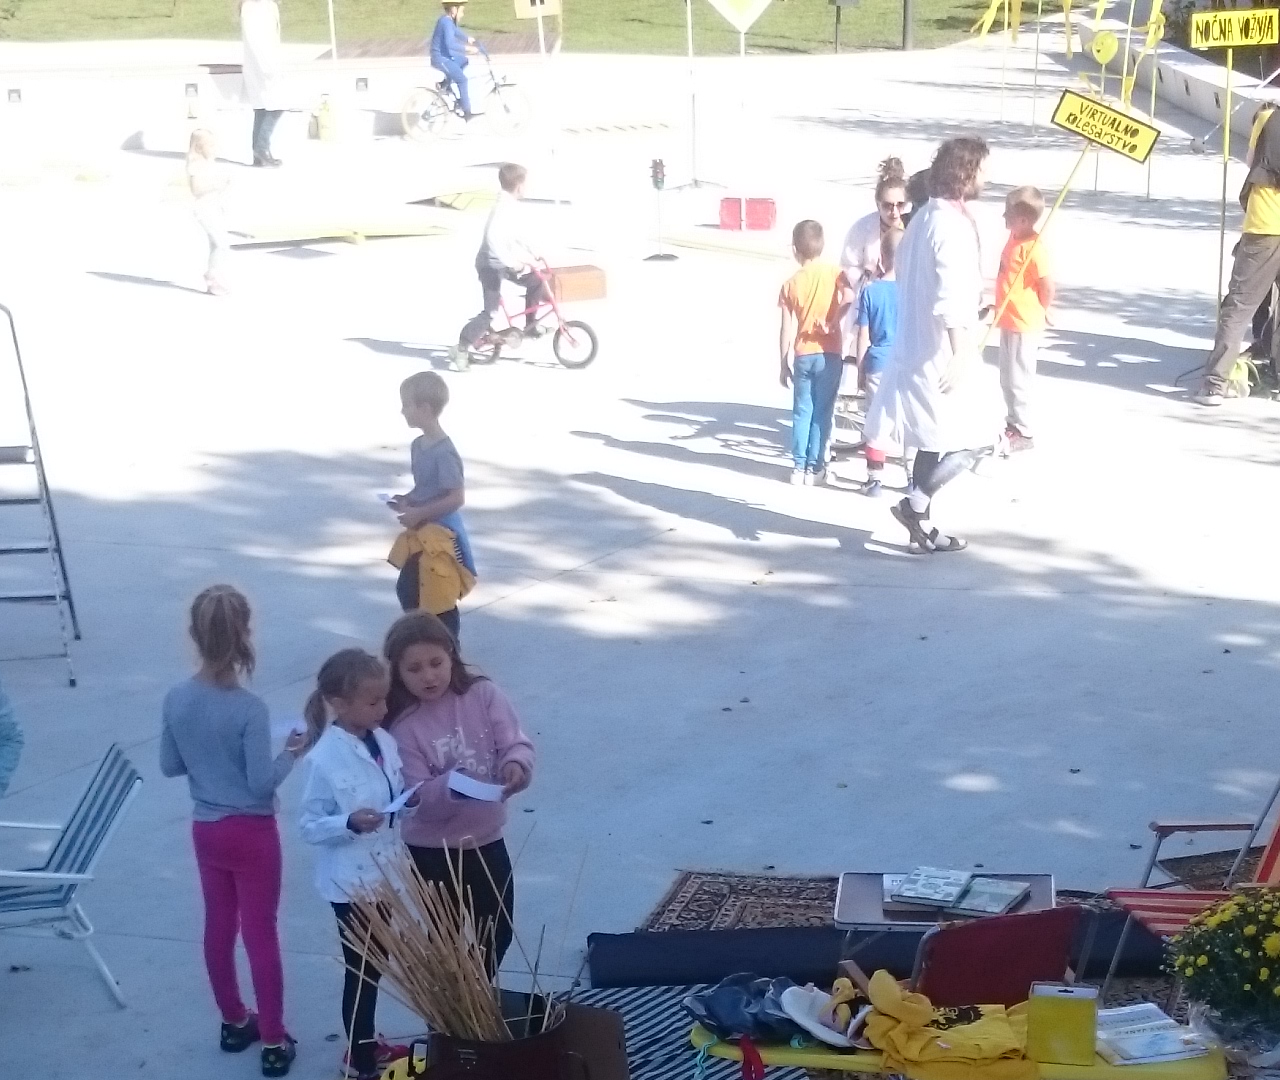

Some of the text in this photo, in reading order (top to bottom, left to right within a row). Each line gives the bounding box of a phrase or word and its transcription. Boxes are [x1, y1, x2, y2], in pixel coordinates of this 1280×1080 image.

[1195, 11, 1273, 44] NOČNA VOŽNJA
[1079, 102, 1139, 138] VIRTUALNO
